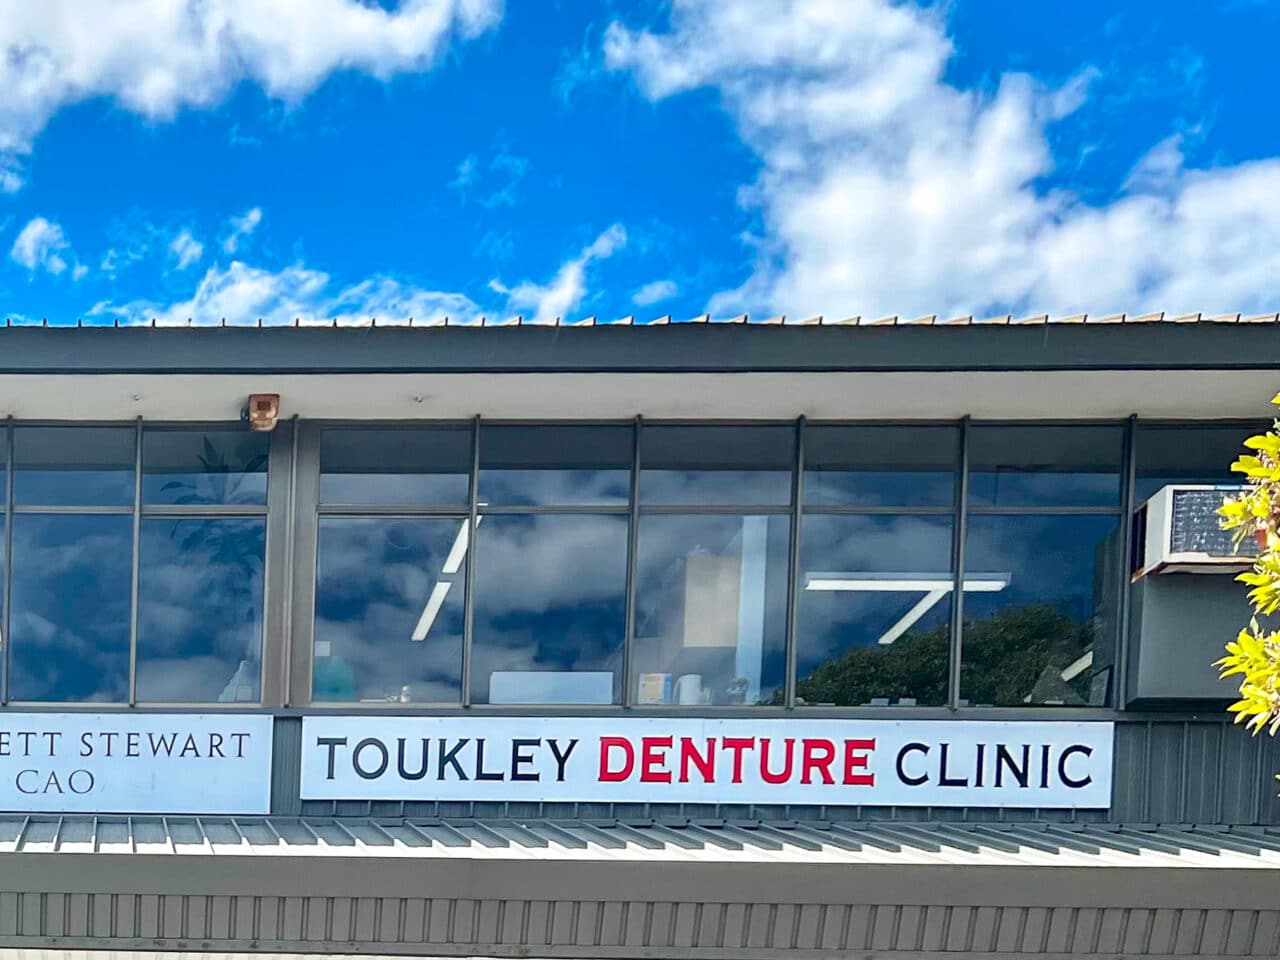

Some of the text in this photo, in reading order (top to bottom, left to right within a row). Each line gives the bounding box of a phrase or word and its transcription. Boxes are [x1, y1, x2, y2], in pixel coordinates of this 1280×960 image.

[79, 731, 251, 759] STEWART
[315, 734, 1095, 790] TOUKLEY DENTURE CLINIC
[15, 768, 96, 795] CAO
